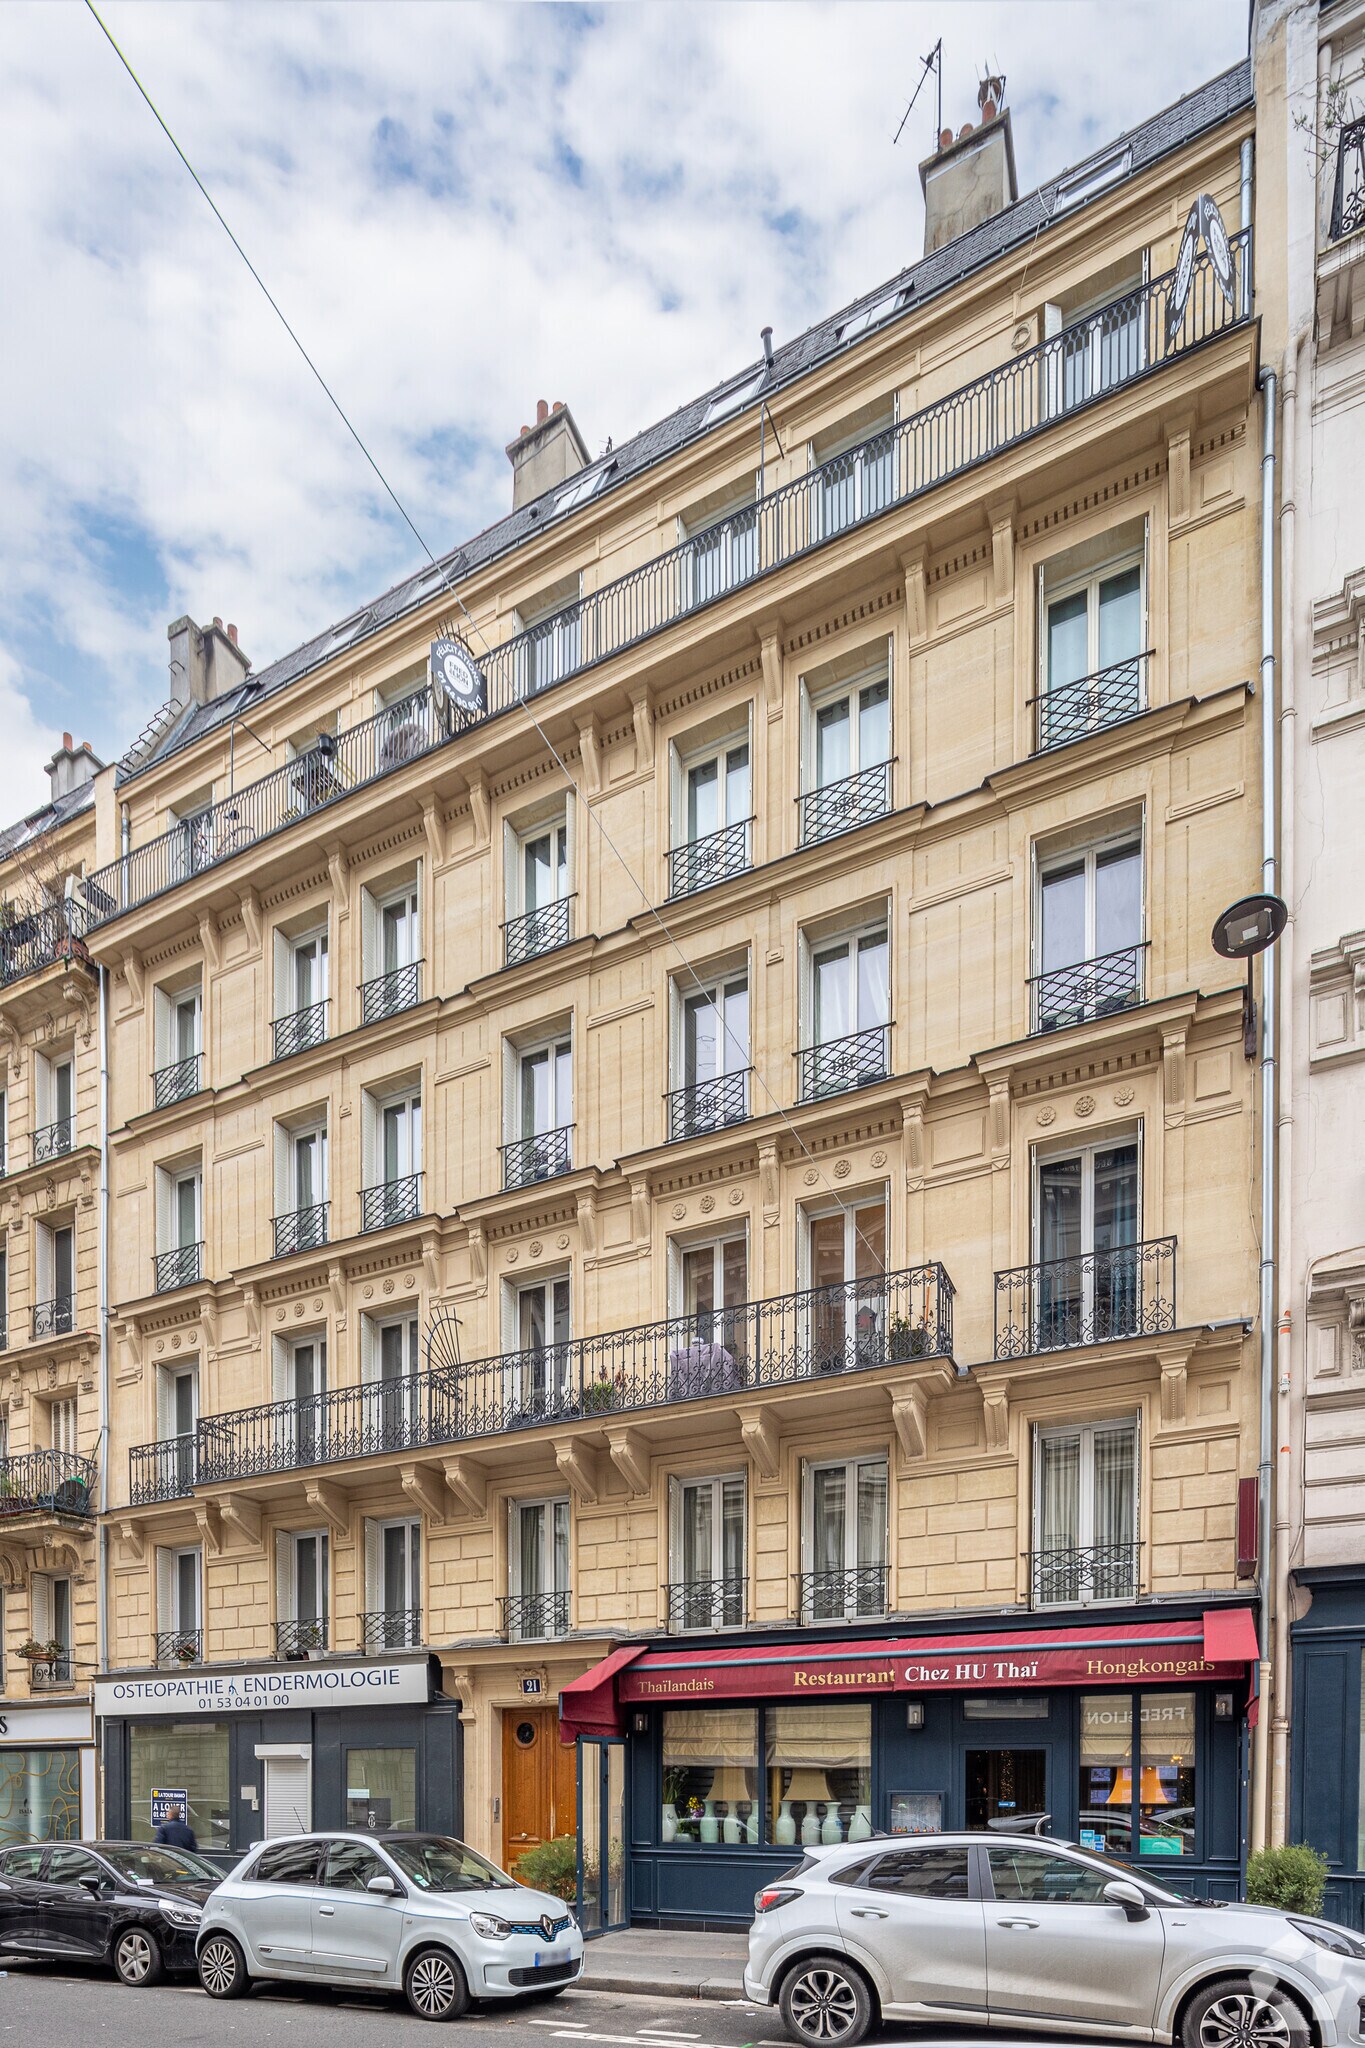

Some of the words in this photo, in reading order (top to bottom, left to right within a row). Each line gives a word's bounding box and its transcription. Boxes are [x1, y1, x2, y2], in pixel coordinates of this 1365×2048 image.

[904, 1665, 950, 1682] Chez
[955, 1663, 987, 1680] HU
[993, 1661, 1039, 1678] Thaï
[1086, 1656, 1215, 1678] Hongkongais
[113, 1679, 224, 1699] OSTEOPATHIE
[244, 1669, 400, 1693] ENDERMOLOGIE
[637, 1677, 714, 1694] Thaïlandais
[793, 1668, 896, 1686] Restaurant
[526, 1680, 537, 1692] 21
[198, 1698, 212, 1709] 01
[216, 1697, 232, 1708] 53
[235, 1696, 250, 1707] 04
[253, 1695, 268, 1706] 01
[273, 1694, 289, 1706] 00
[161, 1803, 185, 1811] LOR
